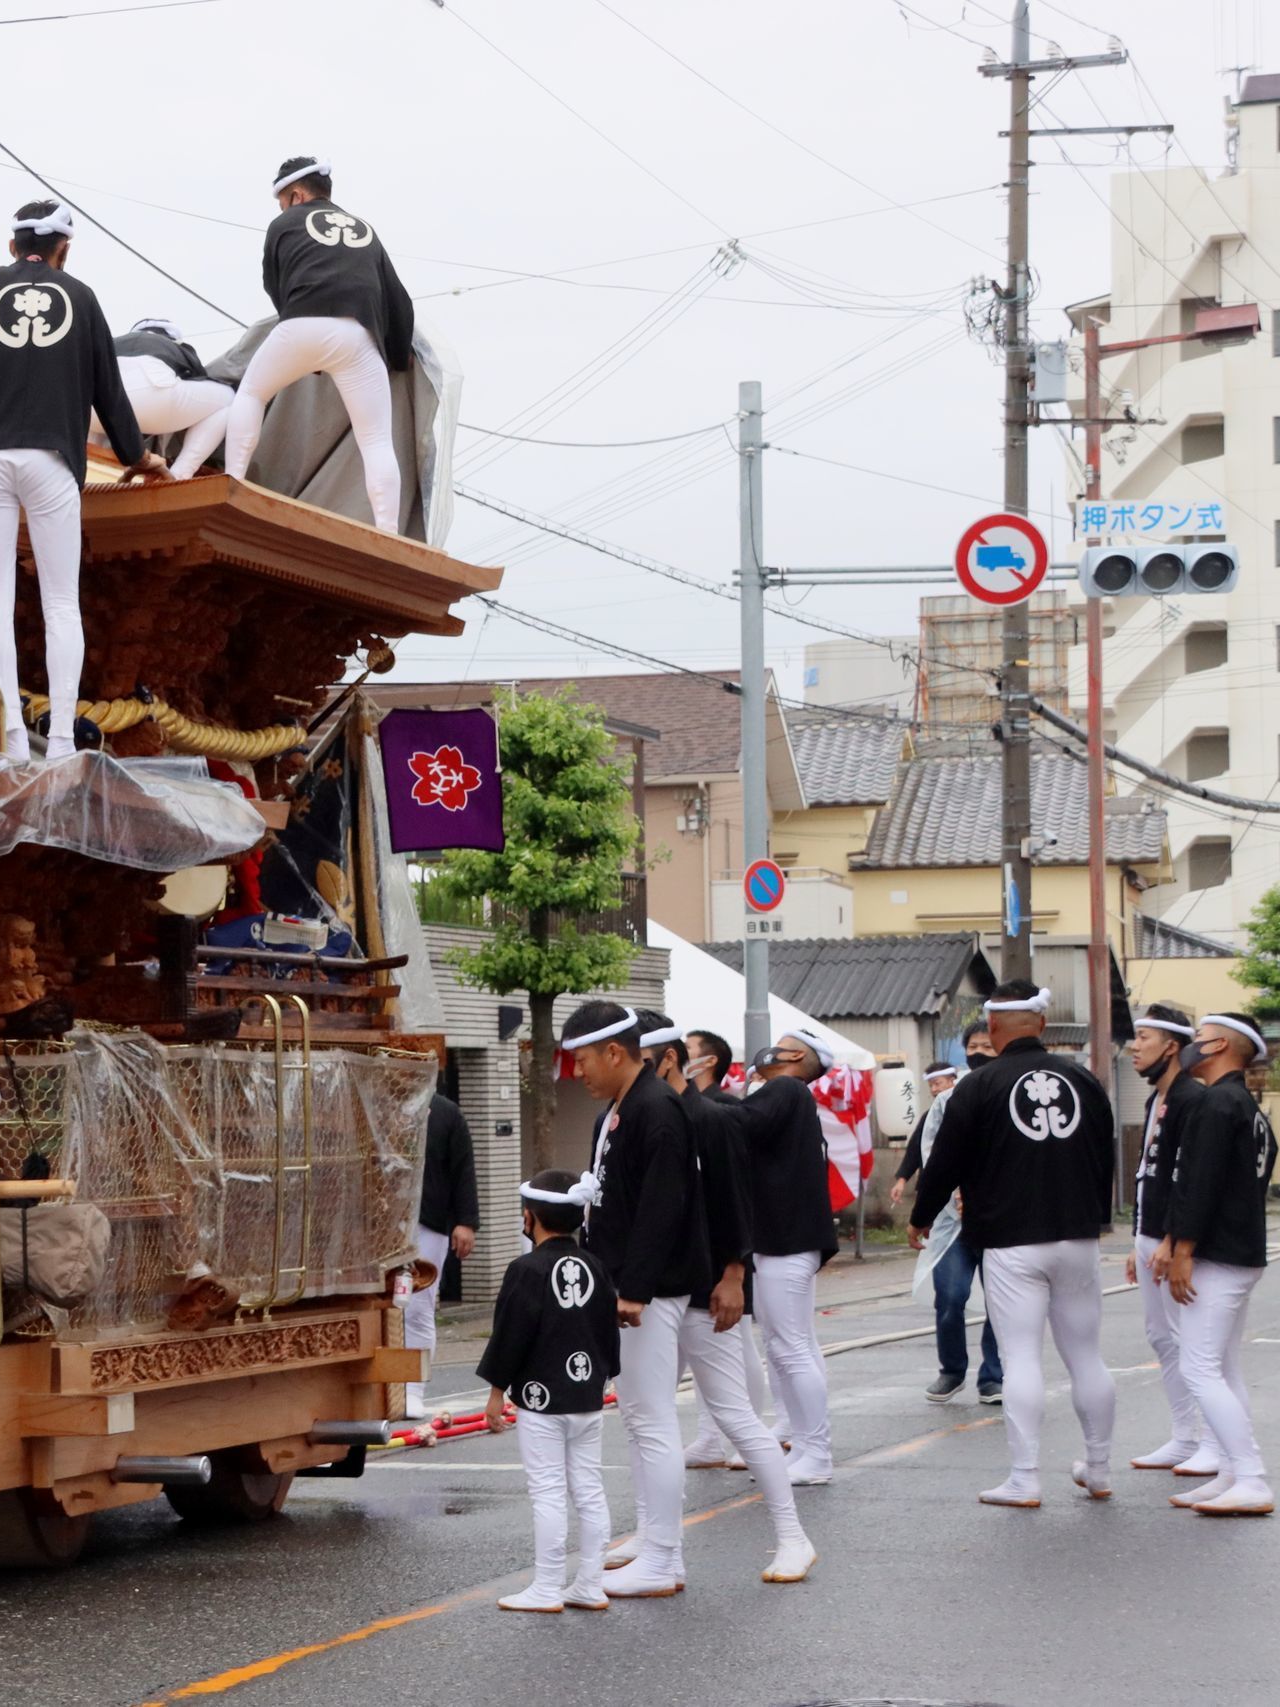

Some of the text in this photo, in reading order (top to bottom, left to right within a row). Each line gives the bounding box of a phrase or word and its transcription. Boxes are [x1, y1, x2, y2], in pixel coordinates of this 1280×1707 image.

[1082, 503, 1222, 532] 押ボタン式
[746, 920, 782, 934] 自動車
